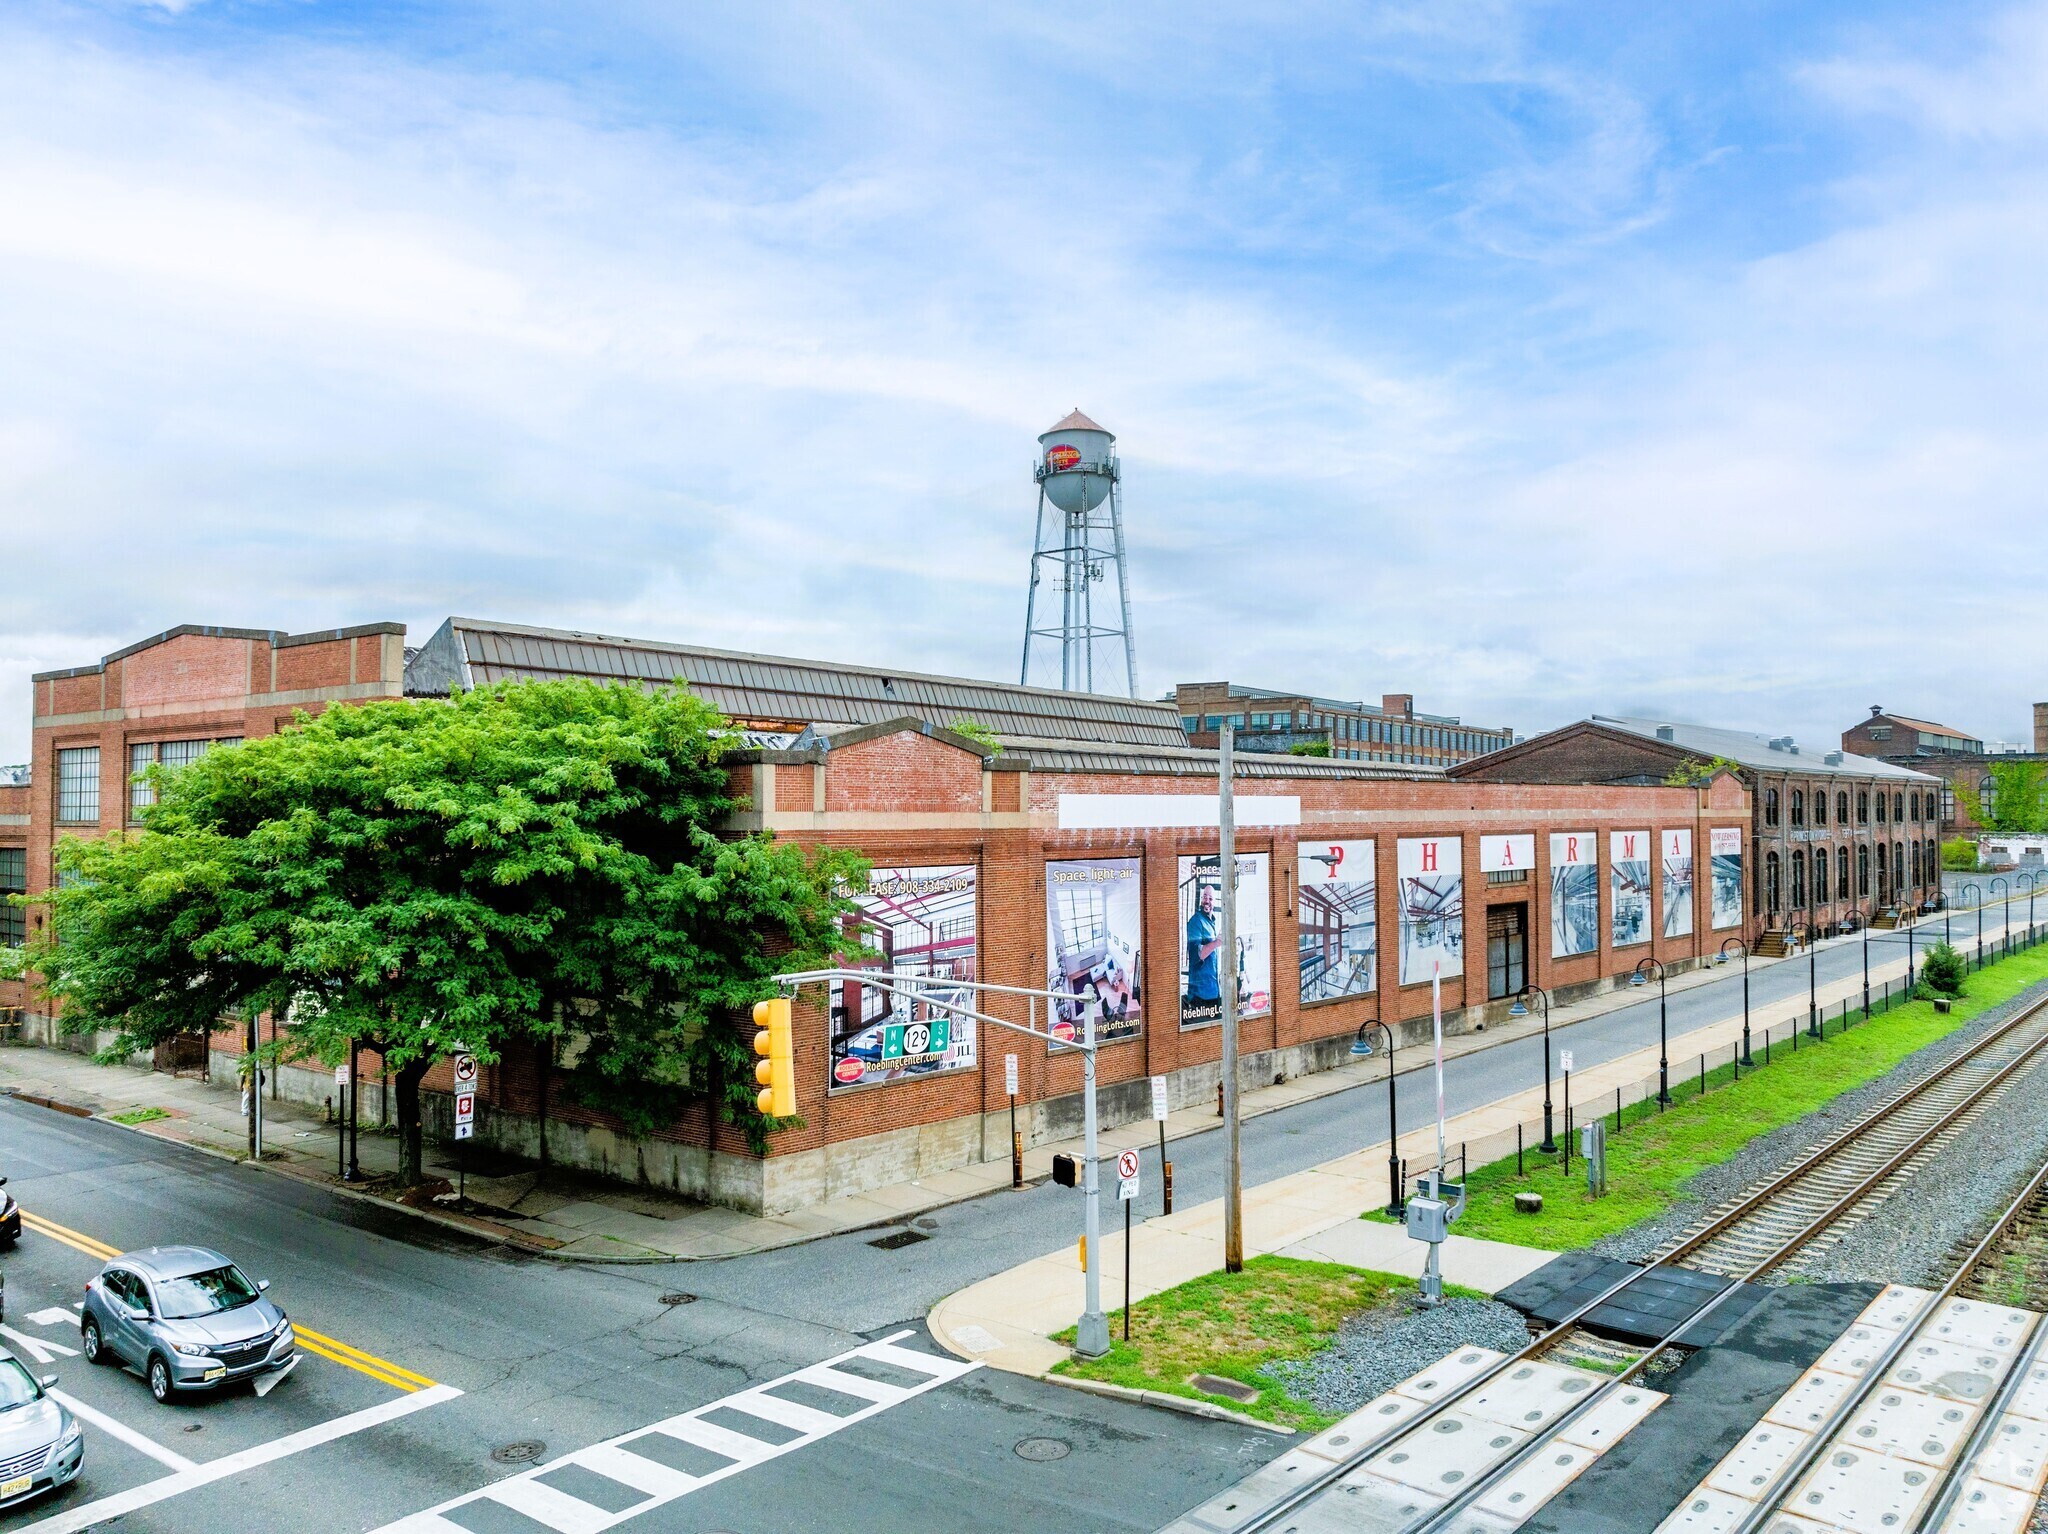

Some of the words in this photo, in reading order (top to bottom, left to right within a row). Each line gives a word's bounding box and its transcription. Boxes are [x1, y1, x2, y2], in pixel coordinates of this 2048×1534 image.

[1244, 862, 1257, 872] air
[1052, 870, 1088, 885] Space,
[1091, 867, 1117, 883] light,
[1119, 867, 1134, 878] air
[900, 878, 968, 894] 908-334-2109
[938, 1024, 943, 1035] S
[1076, 1018, 1140, 1036] RolingLofts.com
[890, 1030, 896, 1041] N
[906, 1030, 928, 1048] 129
[956, 1044, 972, 1057] JLL
[839, 1063, 862, 1071] ROEBLING
[866, 1053, 941, 1072] RoeblingCenter.com
[842, 1070, 859, 1078] CENTER
